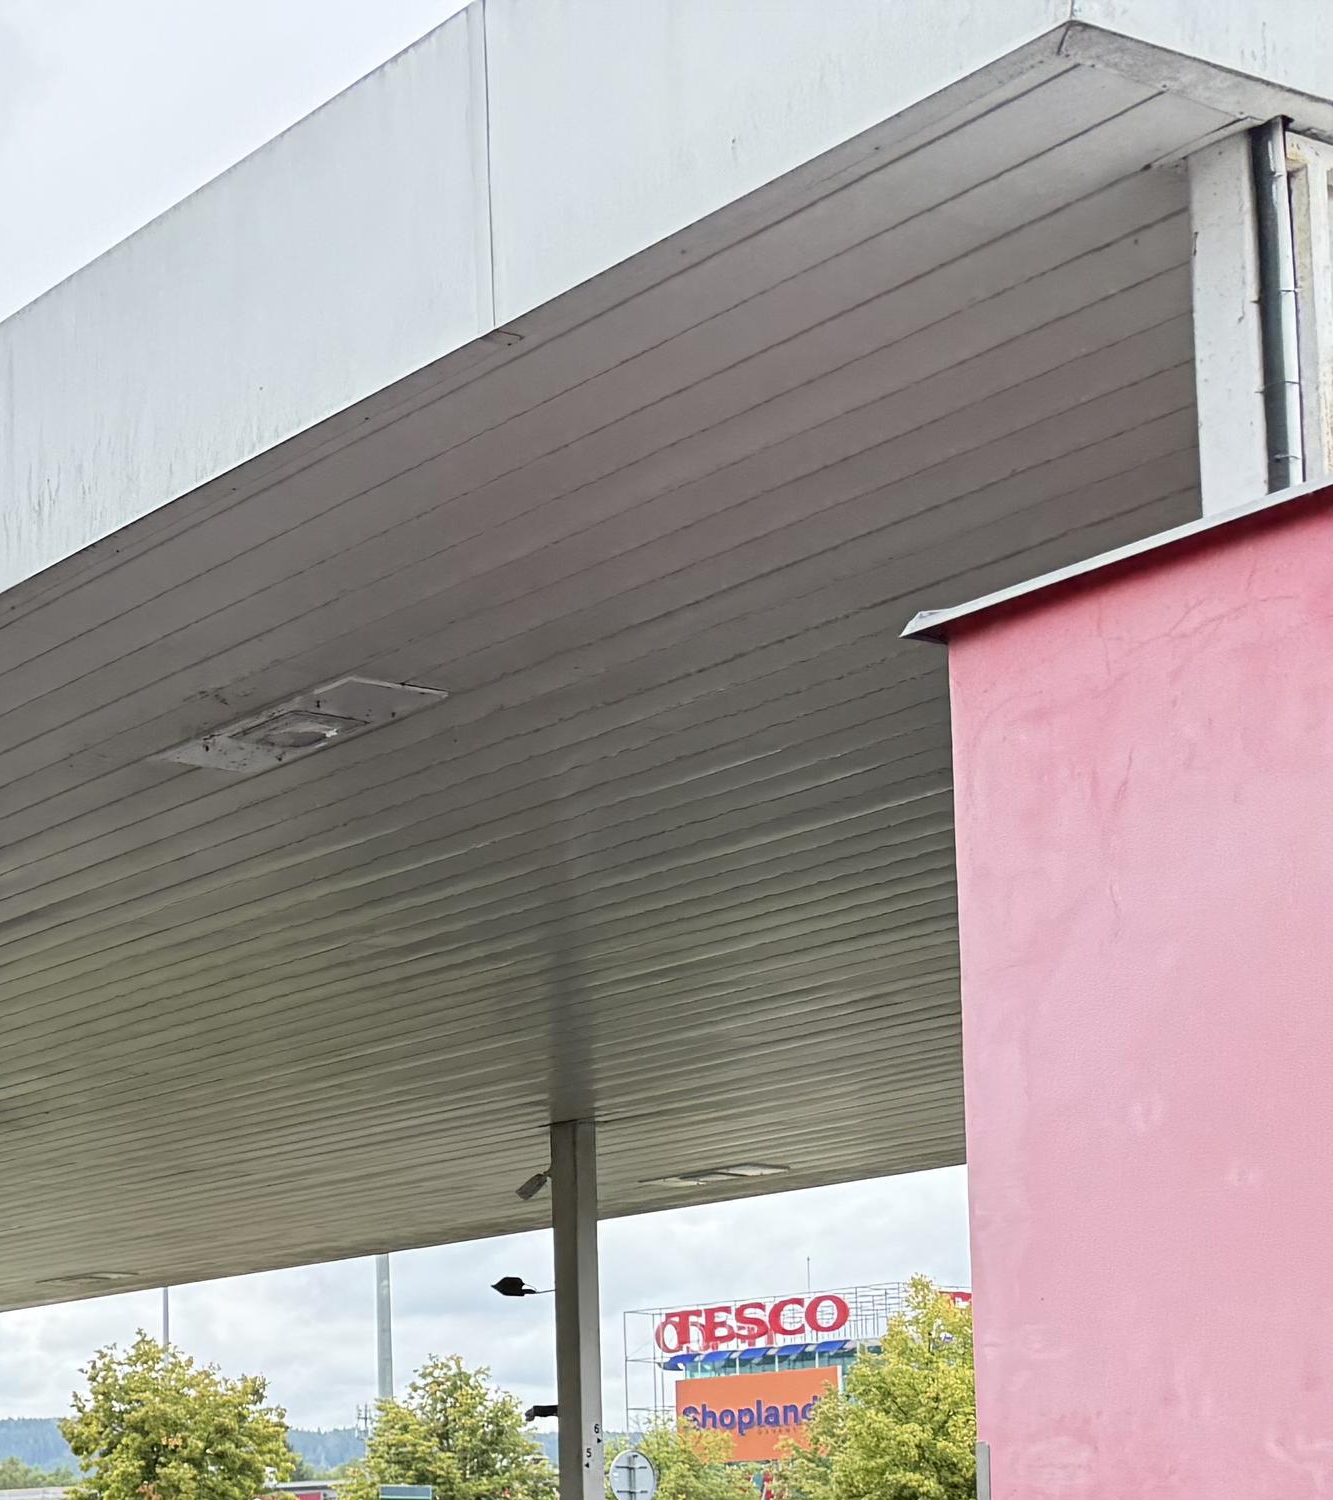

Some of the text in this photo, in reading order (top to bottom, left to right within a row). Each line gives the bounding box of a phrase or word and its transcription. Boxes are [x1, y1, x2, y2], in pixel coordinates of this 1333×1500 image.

[665, 1295, 849, 1345] TESCO
[593, 1423, 600, 1434] 6
[682, 1395, 821, 1436] Shopland
[586, 1448, 592, 1458] 5
